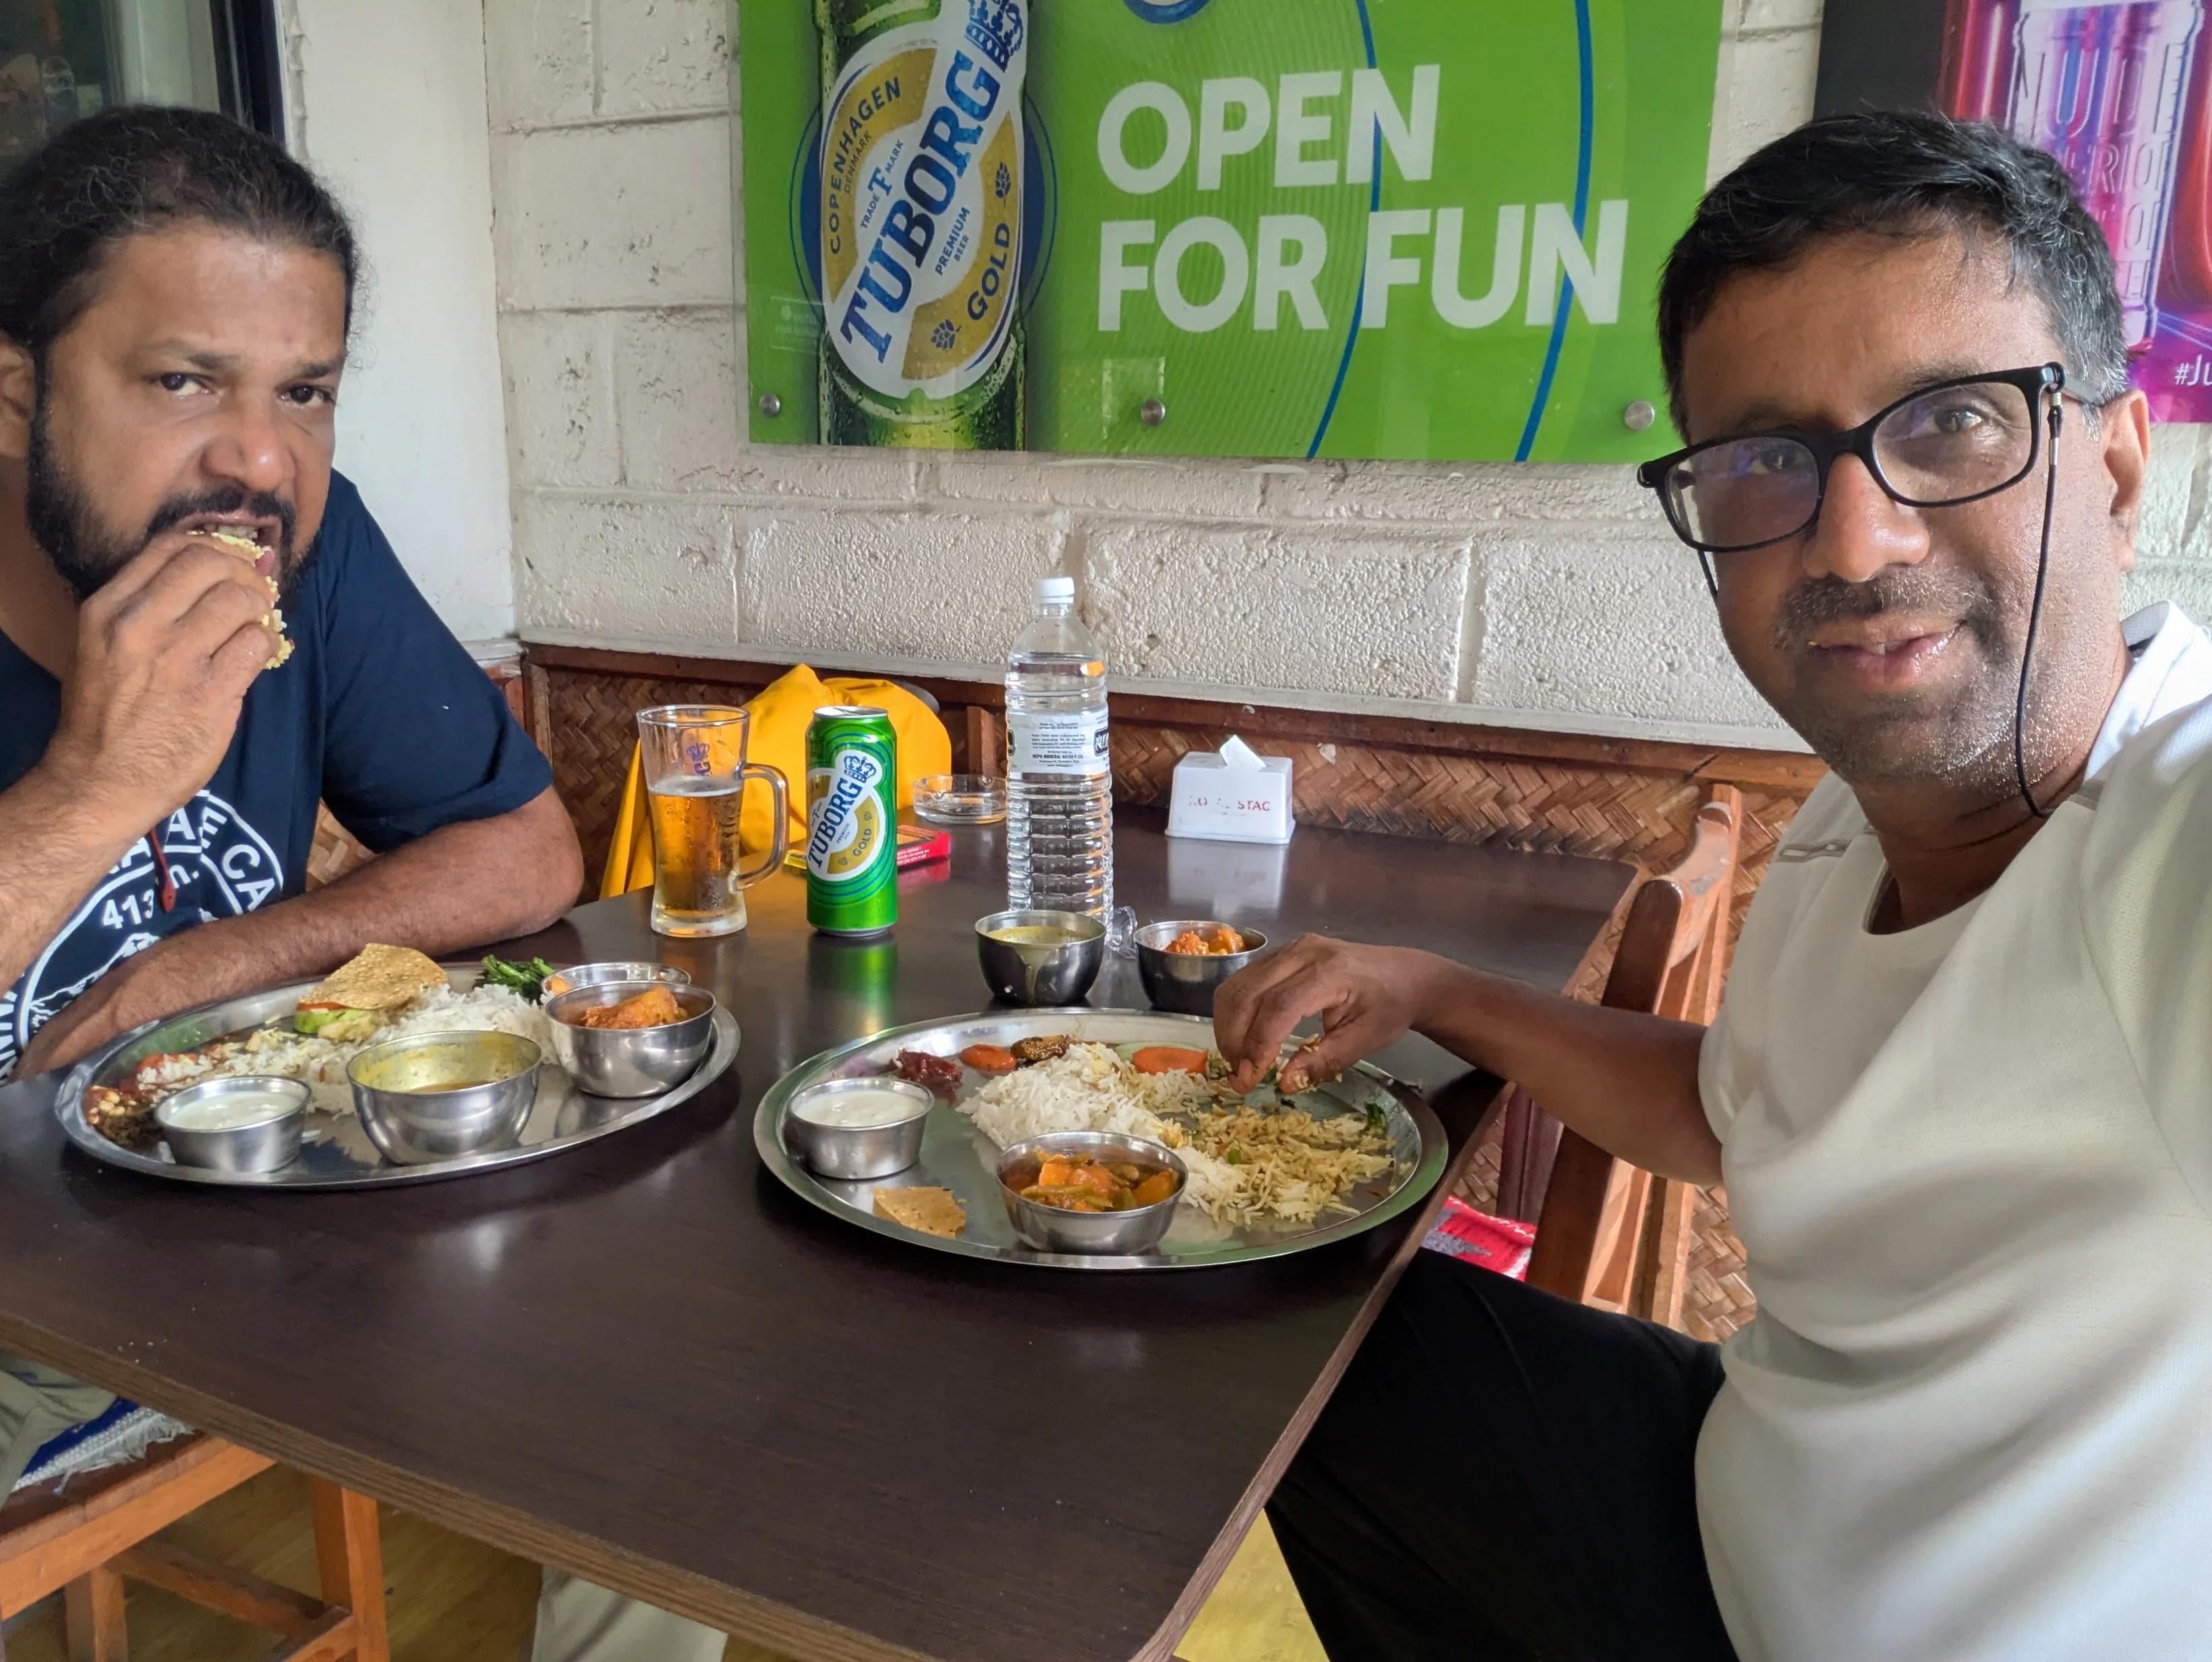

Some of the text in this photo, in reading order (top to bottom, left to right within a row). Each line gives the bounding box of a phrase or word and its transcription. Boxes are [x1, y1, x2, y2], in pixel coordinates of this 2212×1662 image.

[830, 76, 902, 255] COPENHAGEN
[844, 130, 872, 194] DENMARK
[1097, 63, 1440, 195] OPEN
[840, 50, 1003, 364] TUBORG
[861, 193, 880, 229] TRADE
[885, 139, 904, 173] MARK
[935, 206, 970, 277] PREMIUM
[954, 234, 969, 262] BEER
[967, 223, 1010, 320] GOLD
[1097, 200, 1629, 332] FOR FUN
[808, 777, 863, 869] TUBORG
[852, 828, 872, 856] GOLD
